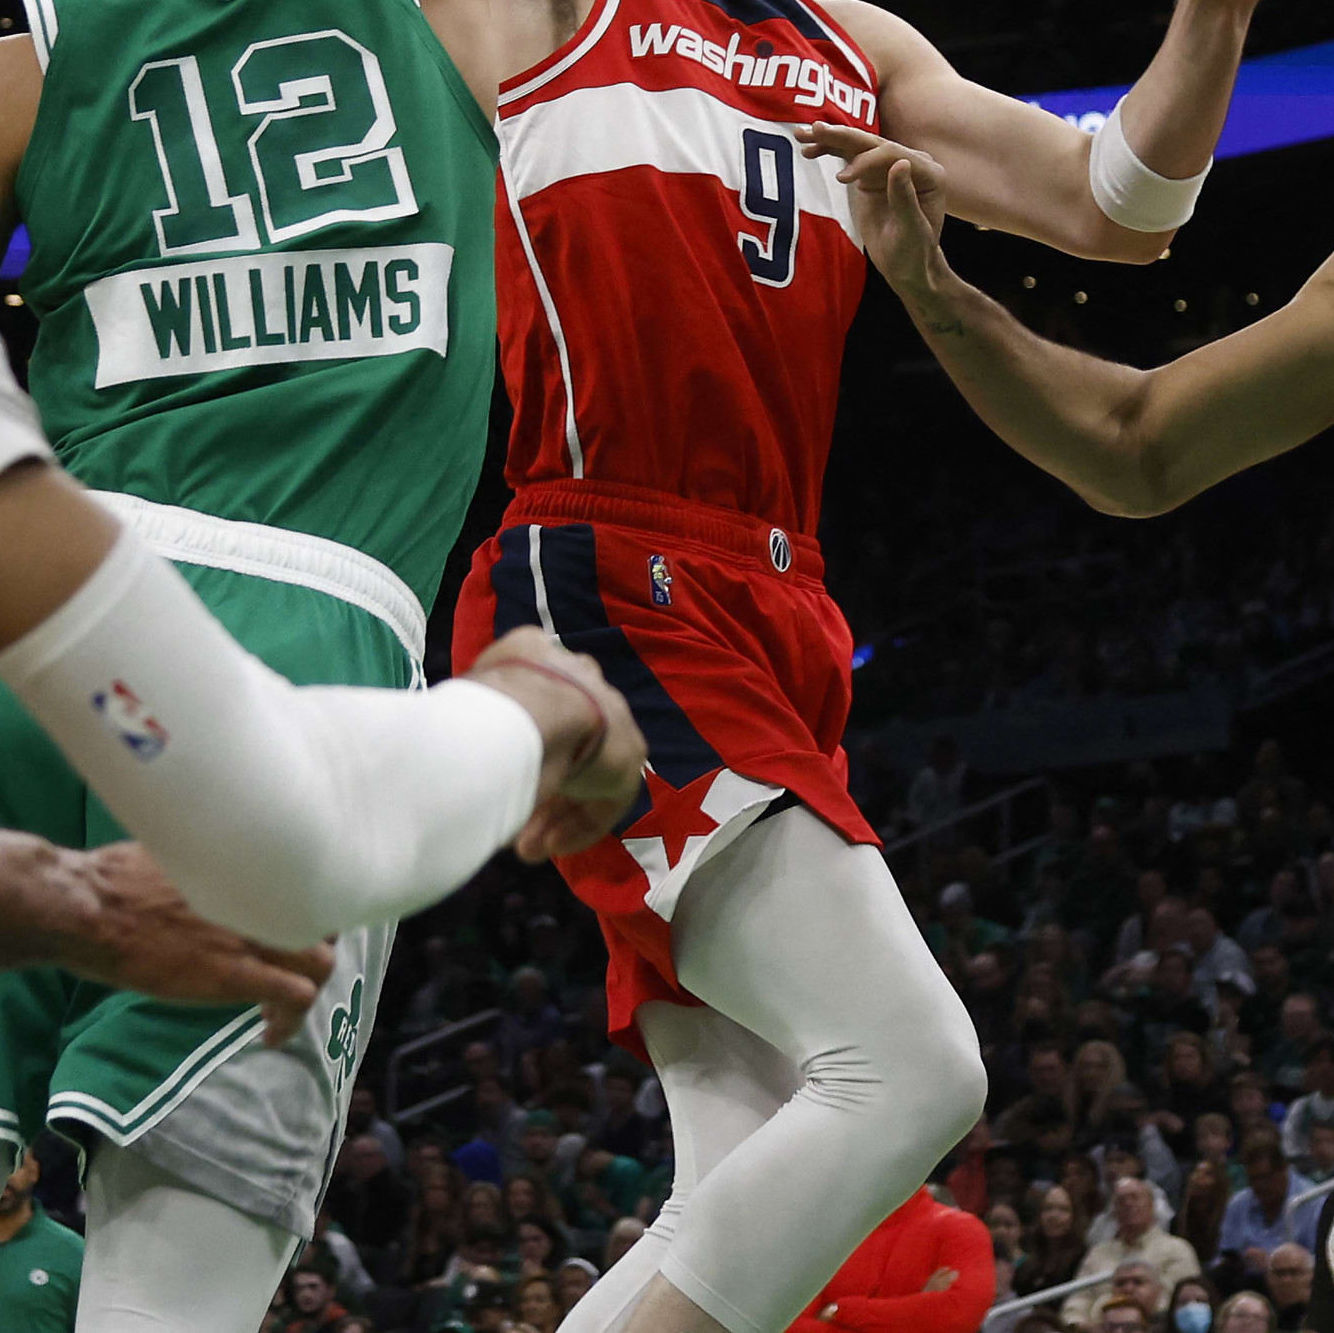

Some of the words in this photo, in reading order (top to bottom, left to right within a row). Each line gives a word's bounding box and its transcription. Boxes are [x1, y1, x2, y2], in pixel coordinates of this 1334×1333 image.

[629, 21, 877, 126] washington
[128, 29, 419, 257] 12
[737, 128, 801, 289] 9
[140, 258, 421, 359] WILLIAMS
